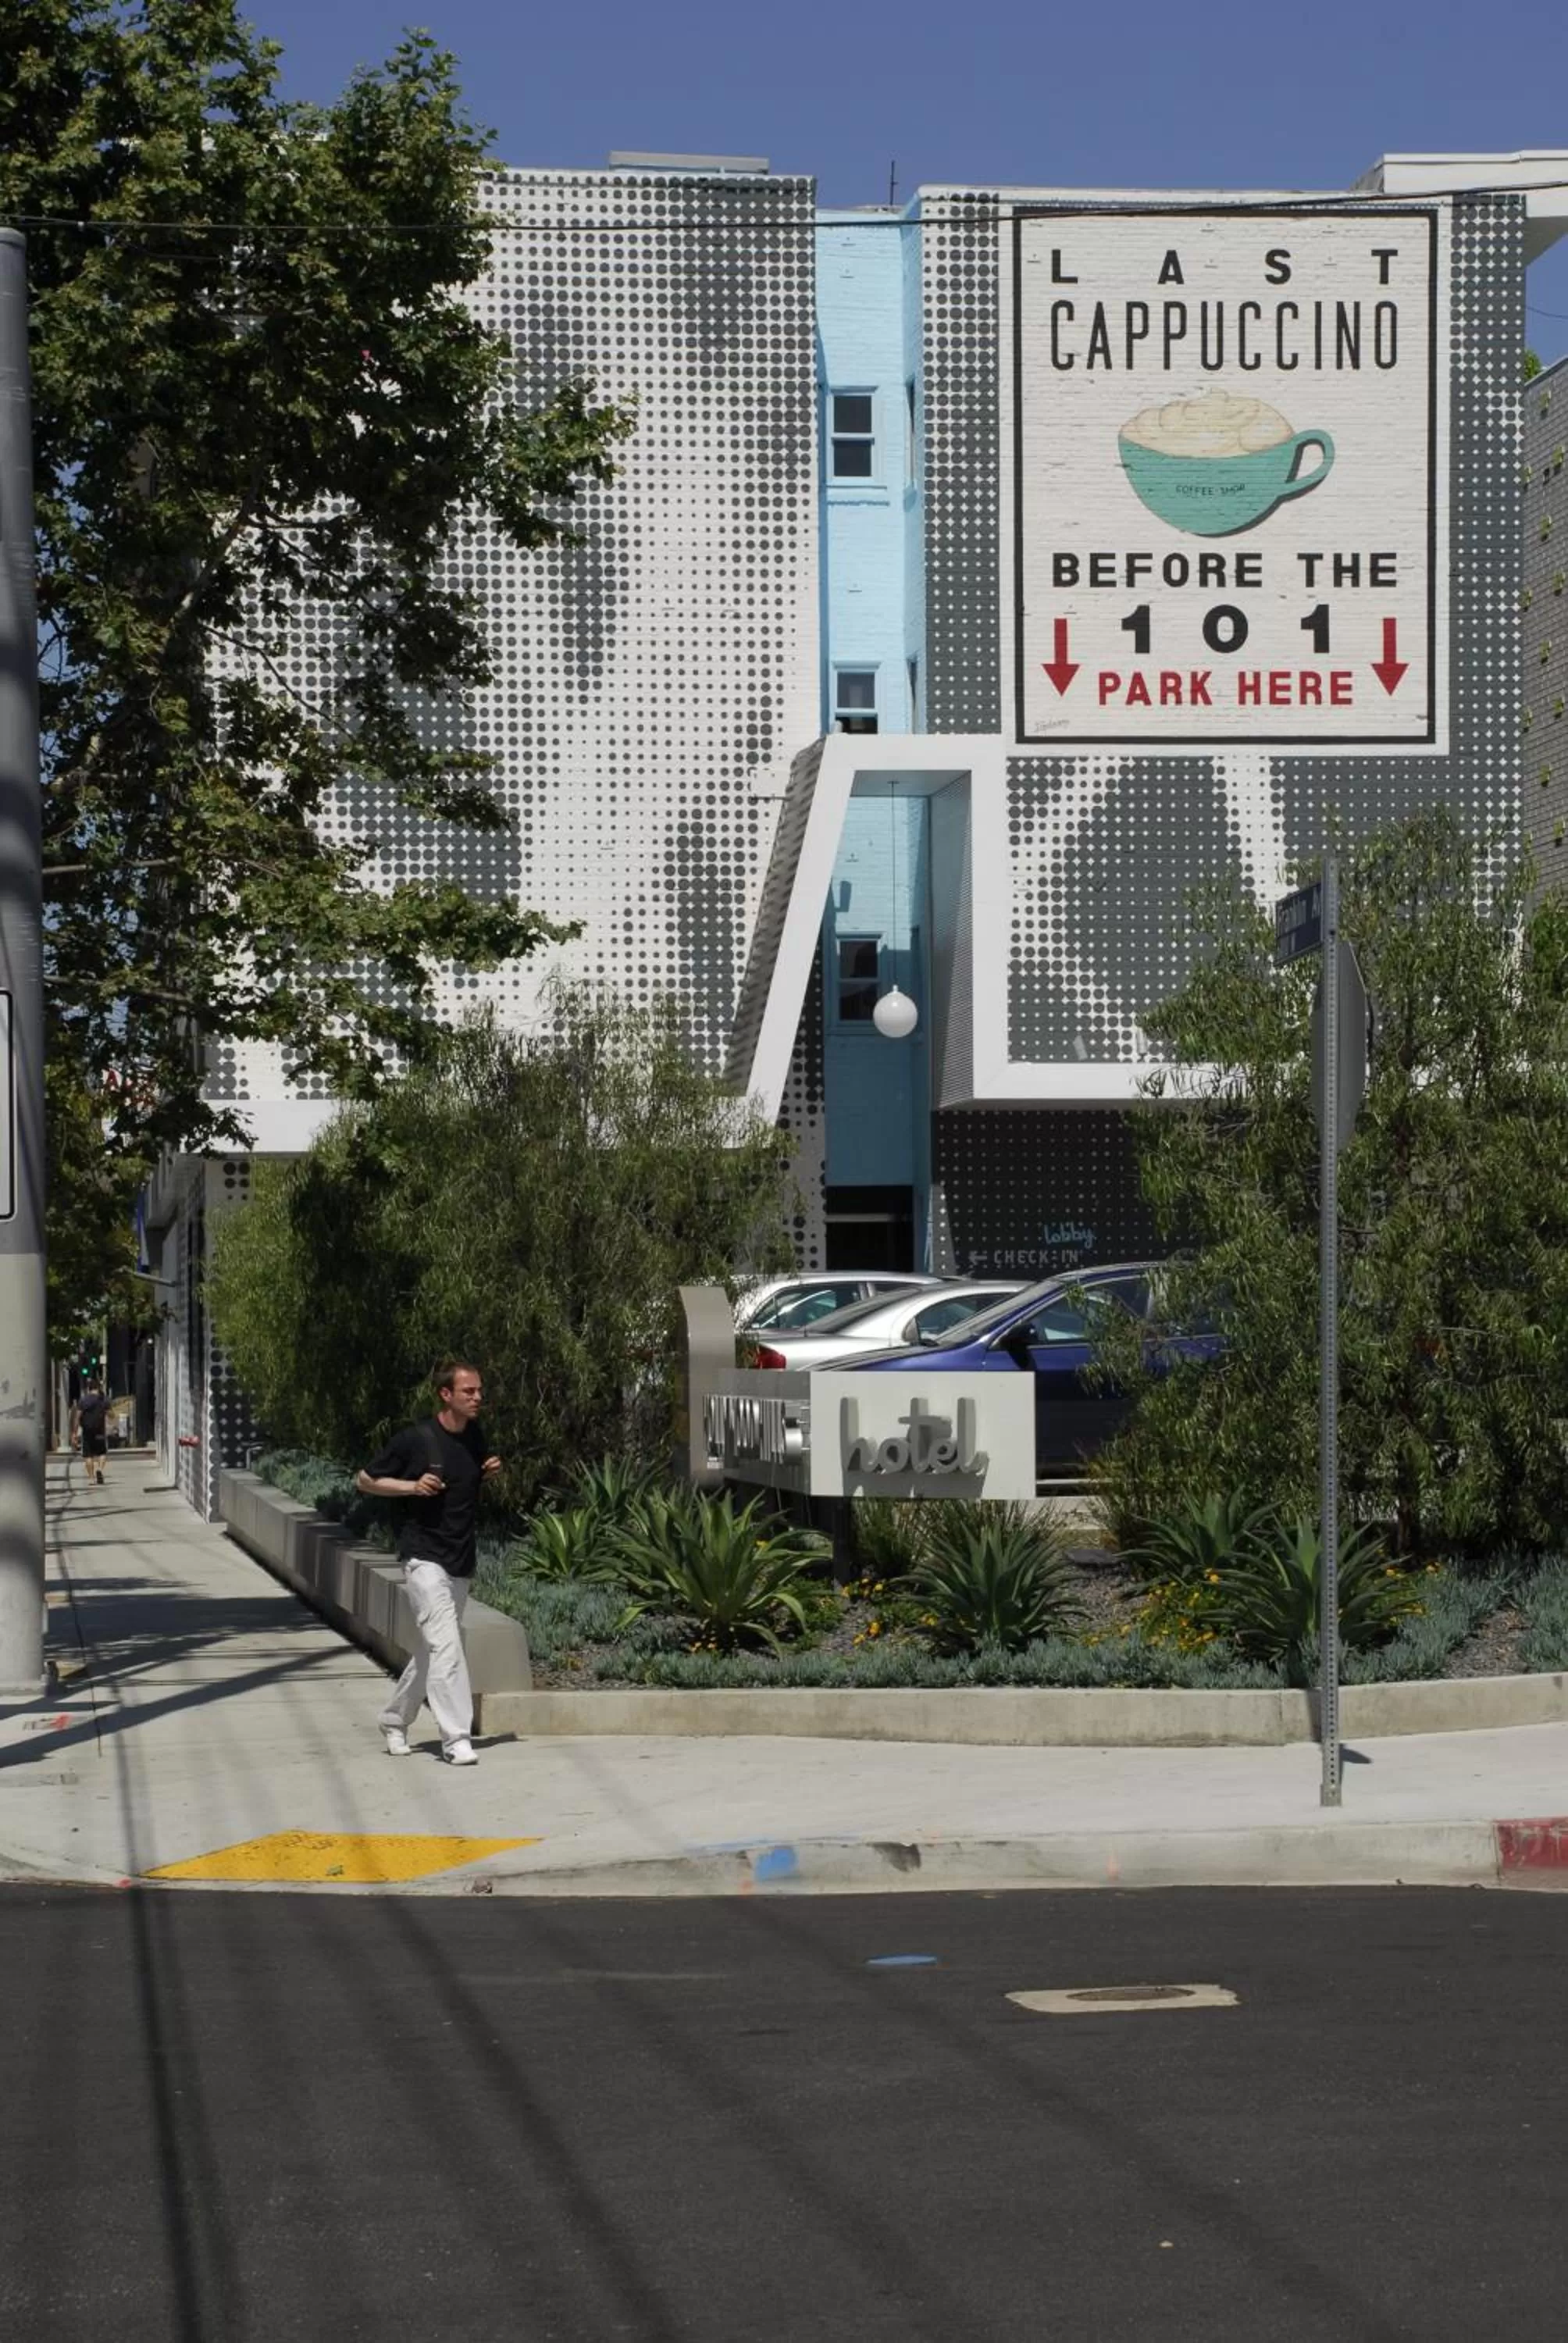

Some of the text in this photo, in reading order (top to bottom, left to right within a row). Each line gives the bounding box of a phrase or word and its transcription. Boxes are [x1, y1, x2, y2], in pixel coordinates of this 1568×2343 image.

[1051, 249, 1399, 285] LAST
[1050, 299, 1399, 371] CAPPUCCINO
[1053, 552, 1398, 588] BEFORE THE
[1121, 604, 1330, 654] 101
[1098, 669, 1353, 706] PARK HERE
[839, 1396, 990, 1475] hotel
